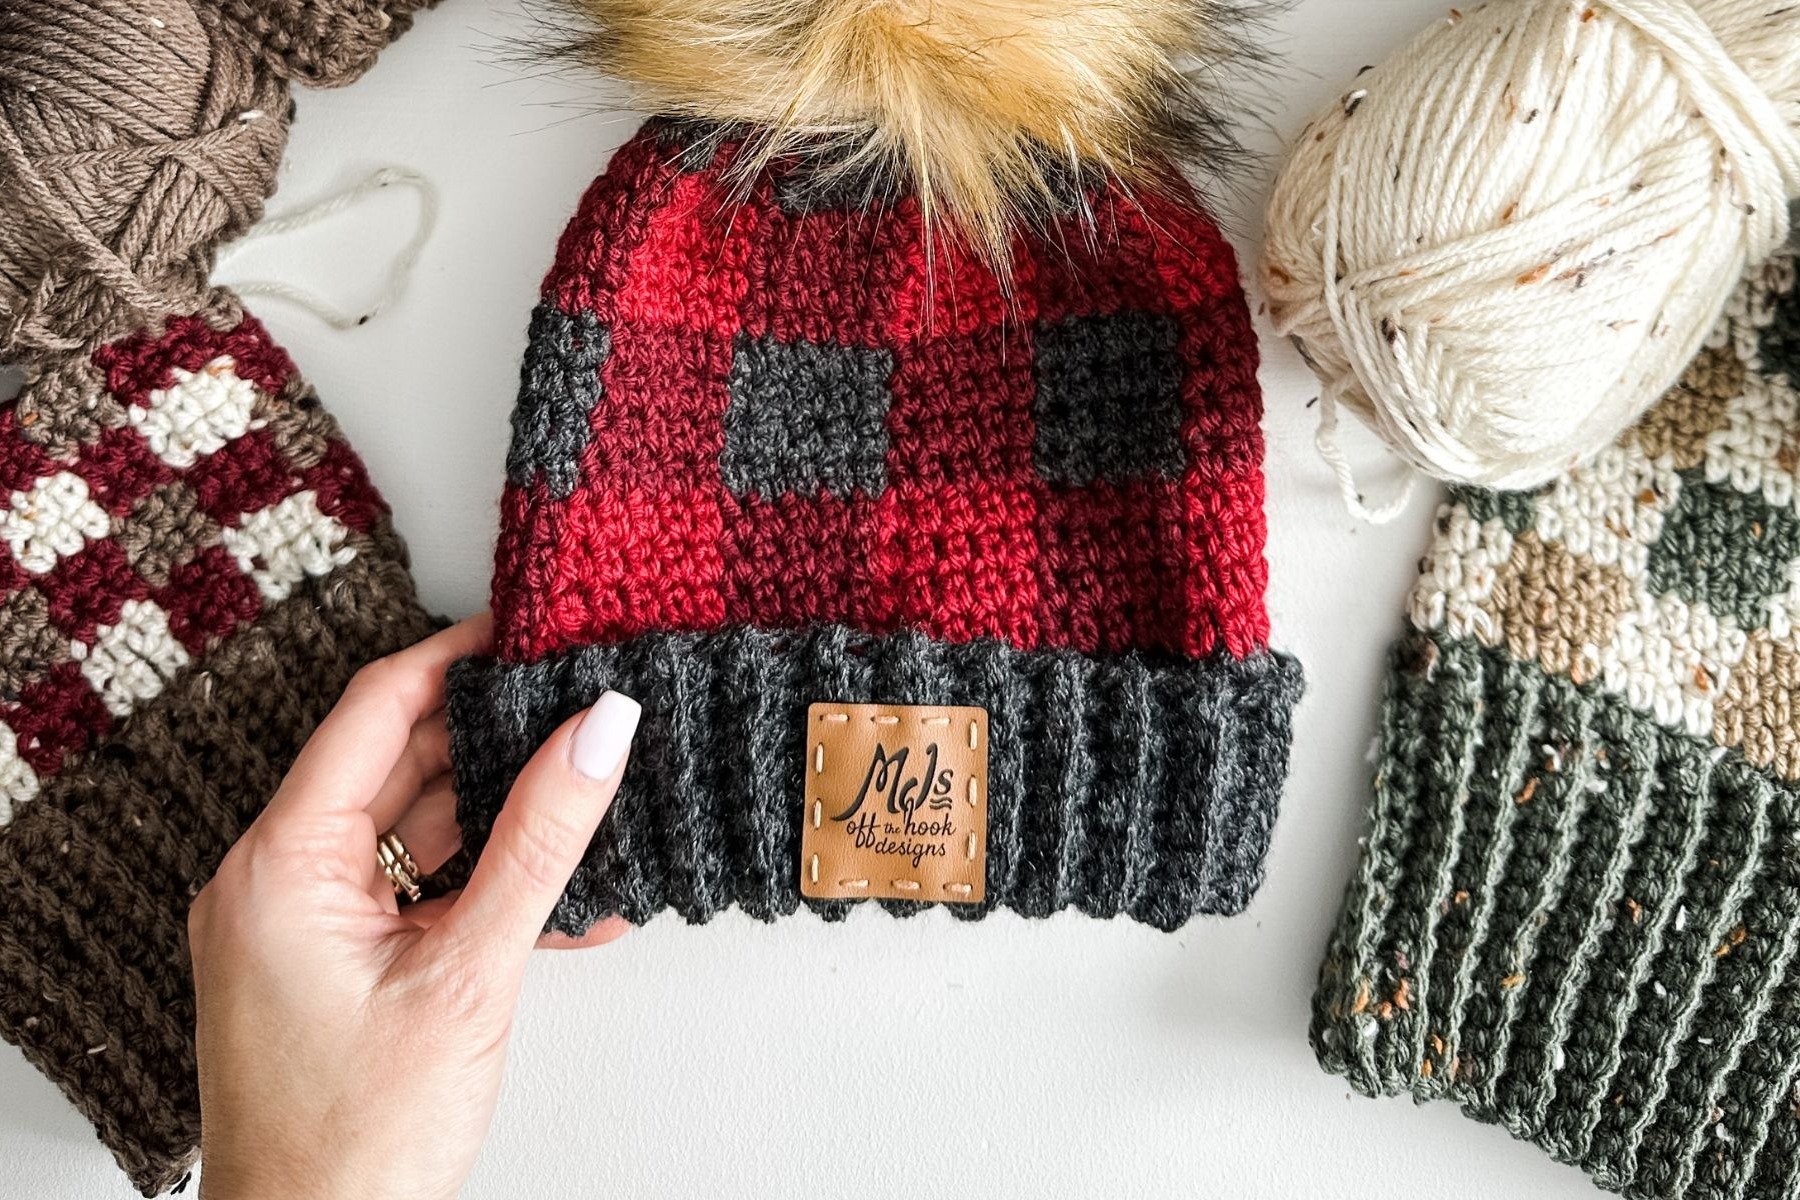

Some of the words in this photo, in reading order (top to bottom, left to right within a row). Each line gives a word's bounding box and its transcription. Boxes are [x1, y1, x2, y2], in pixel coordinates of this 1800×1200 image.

[846, 812, 881, 848] off
[884, 821, 901, 835] the
[903, 797, 957, 836] hook
[875, 837, 947, 868] designs
